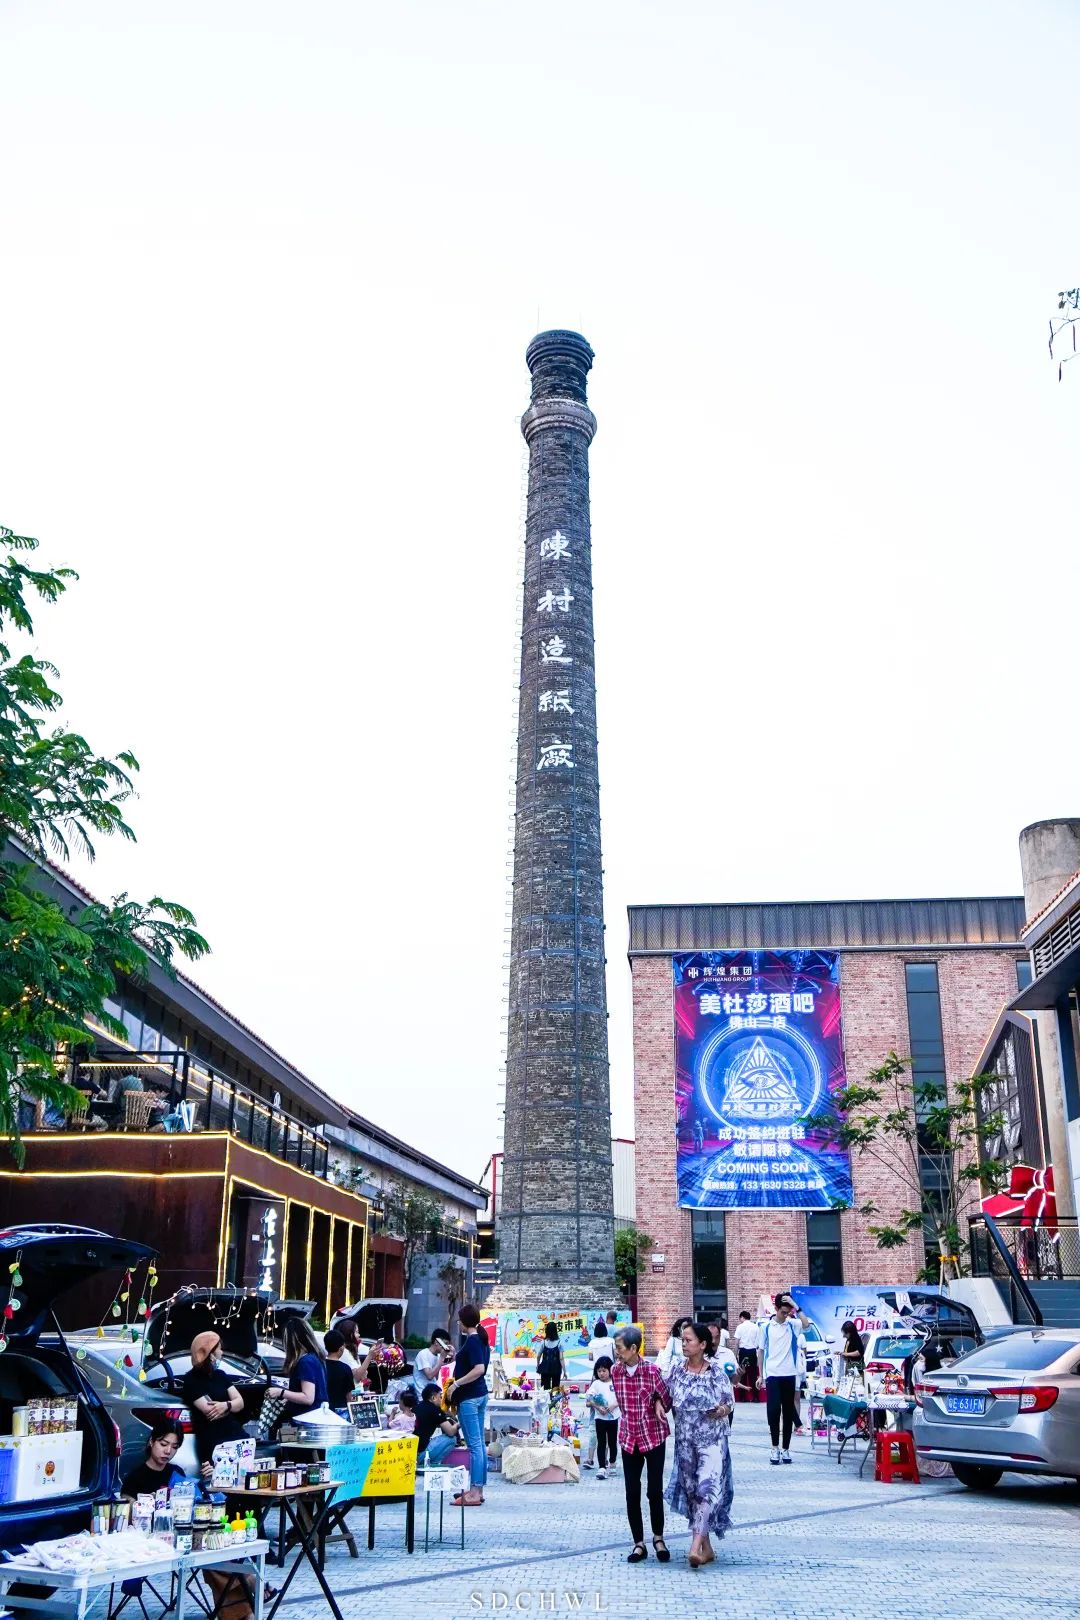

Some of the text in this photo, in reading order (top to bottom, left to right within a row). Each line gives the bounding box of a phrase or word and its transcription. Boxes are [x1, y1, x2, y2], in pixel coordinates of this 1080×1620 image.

[703, 966, 752, 976] 辉煌集团
[700, 993, 815, 1014] 美杜莎酒吧
[718, 1162, 809, 1174] COMING SOON
[834, 1305, 878, 1318] 广汽三菱
